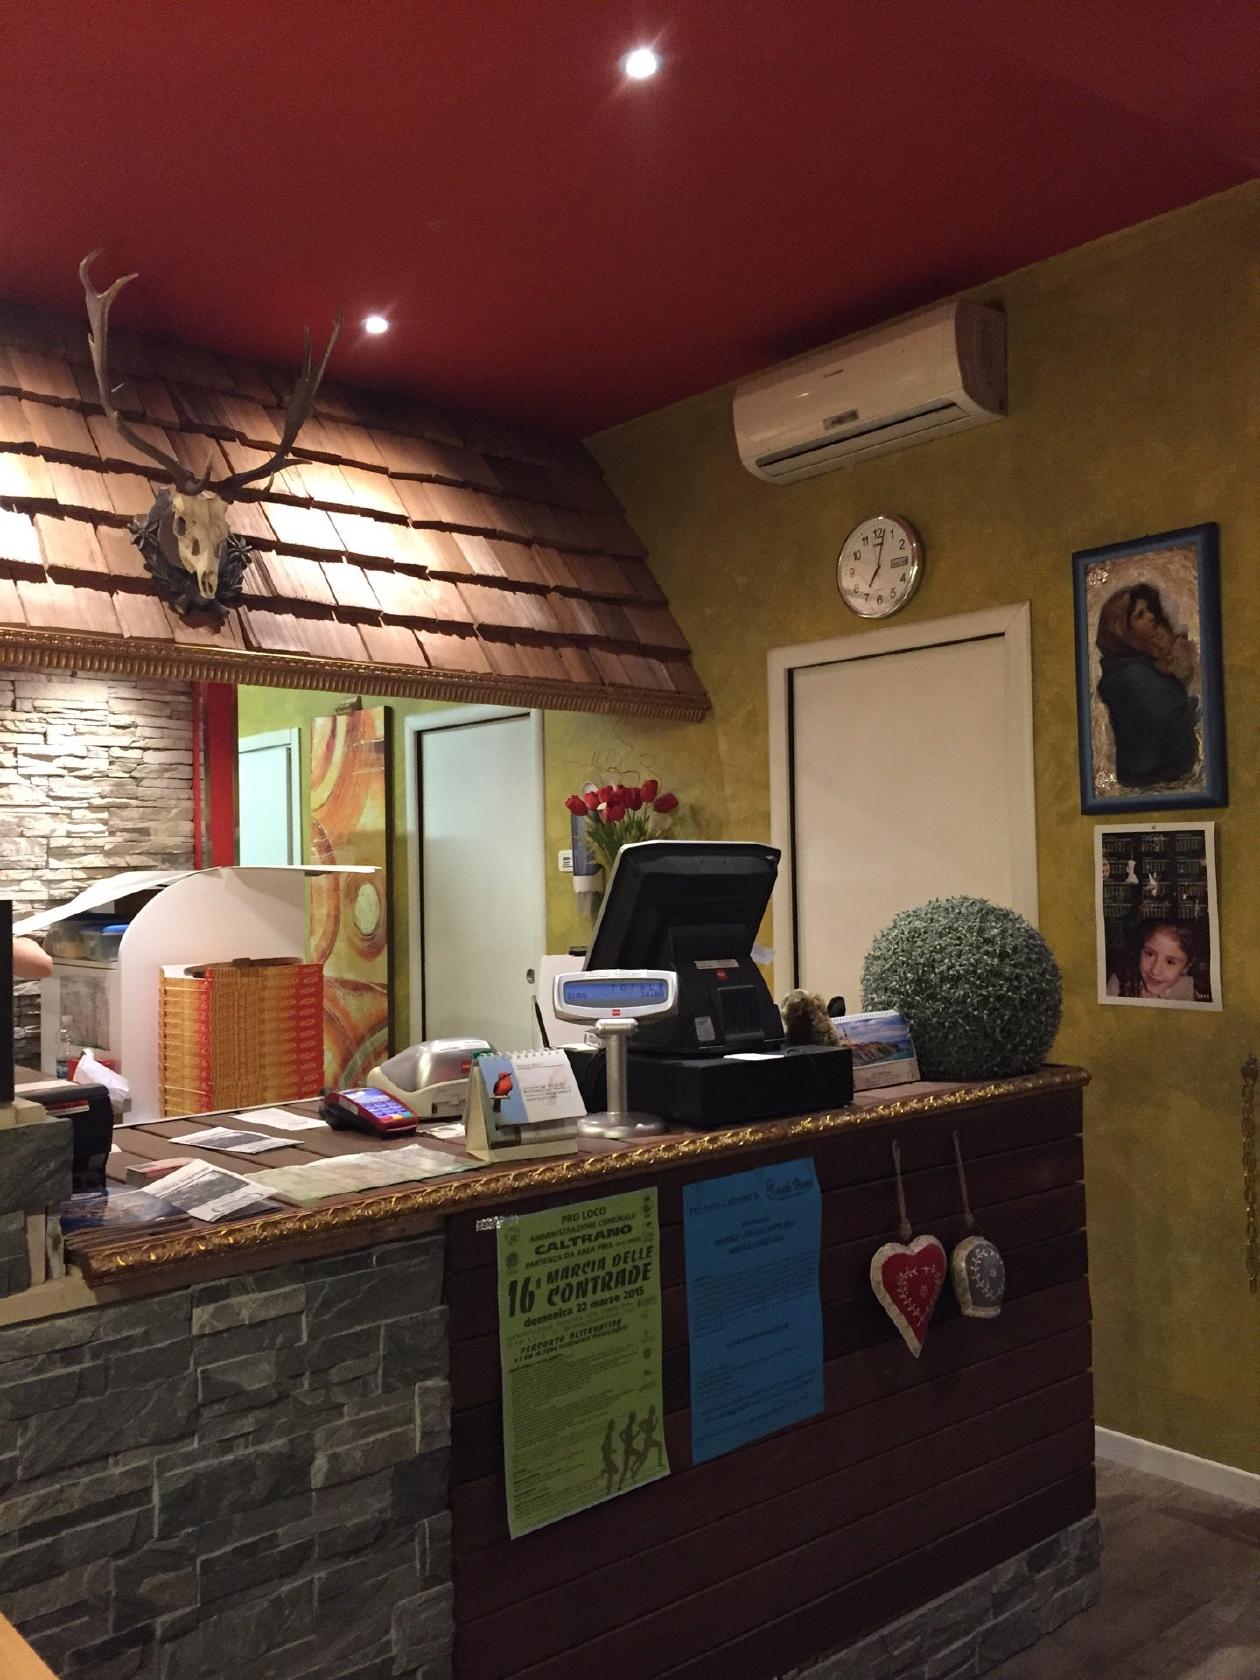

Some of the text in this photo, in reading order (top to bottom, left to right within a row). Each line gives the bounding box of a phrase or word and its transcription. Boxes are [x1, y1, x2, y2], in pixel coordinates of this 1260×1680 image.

[862, 536, 869, 546] 11
[873, 528, 883, 539] 12
[899, 539, 905, 550] 2
[900, 573, 906, 583] 4
[890, 587, 896, 598] 5
[561, 1206, 607, 1225] PRO LOCO
[534, 1224, 633, 1256] CALTRANO
[546, 1256, 607, 1286] MARCIA
[611, 1245, 654, 1268] DELLE
[546, 1262, 653, 1307] CONTRADE
[523, 1306, 574, 1329] domenica
[576, 1301, 588, 1313] 22
[590, 1294, 621, 1309] marzo
[623, 1286, 645, 1300] 2015
